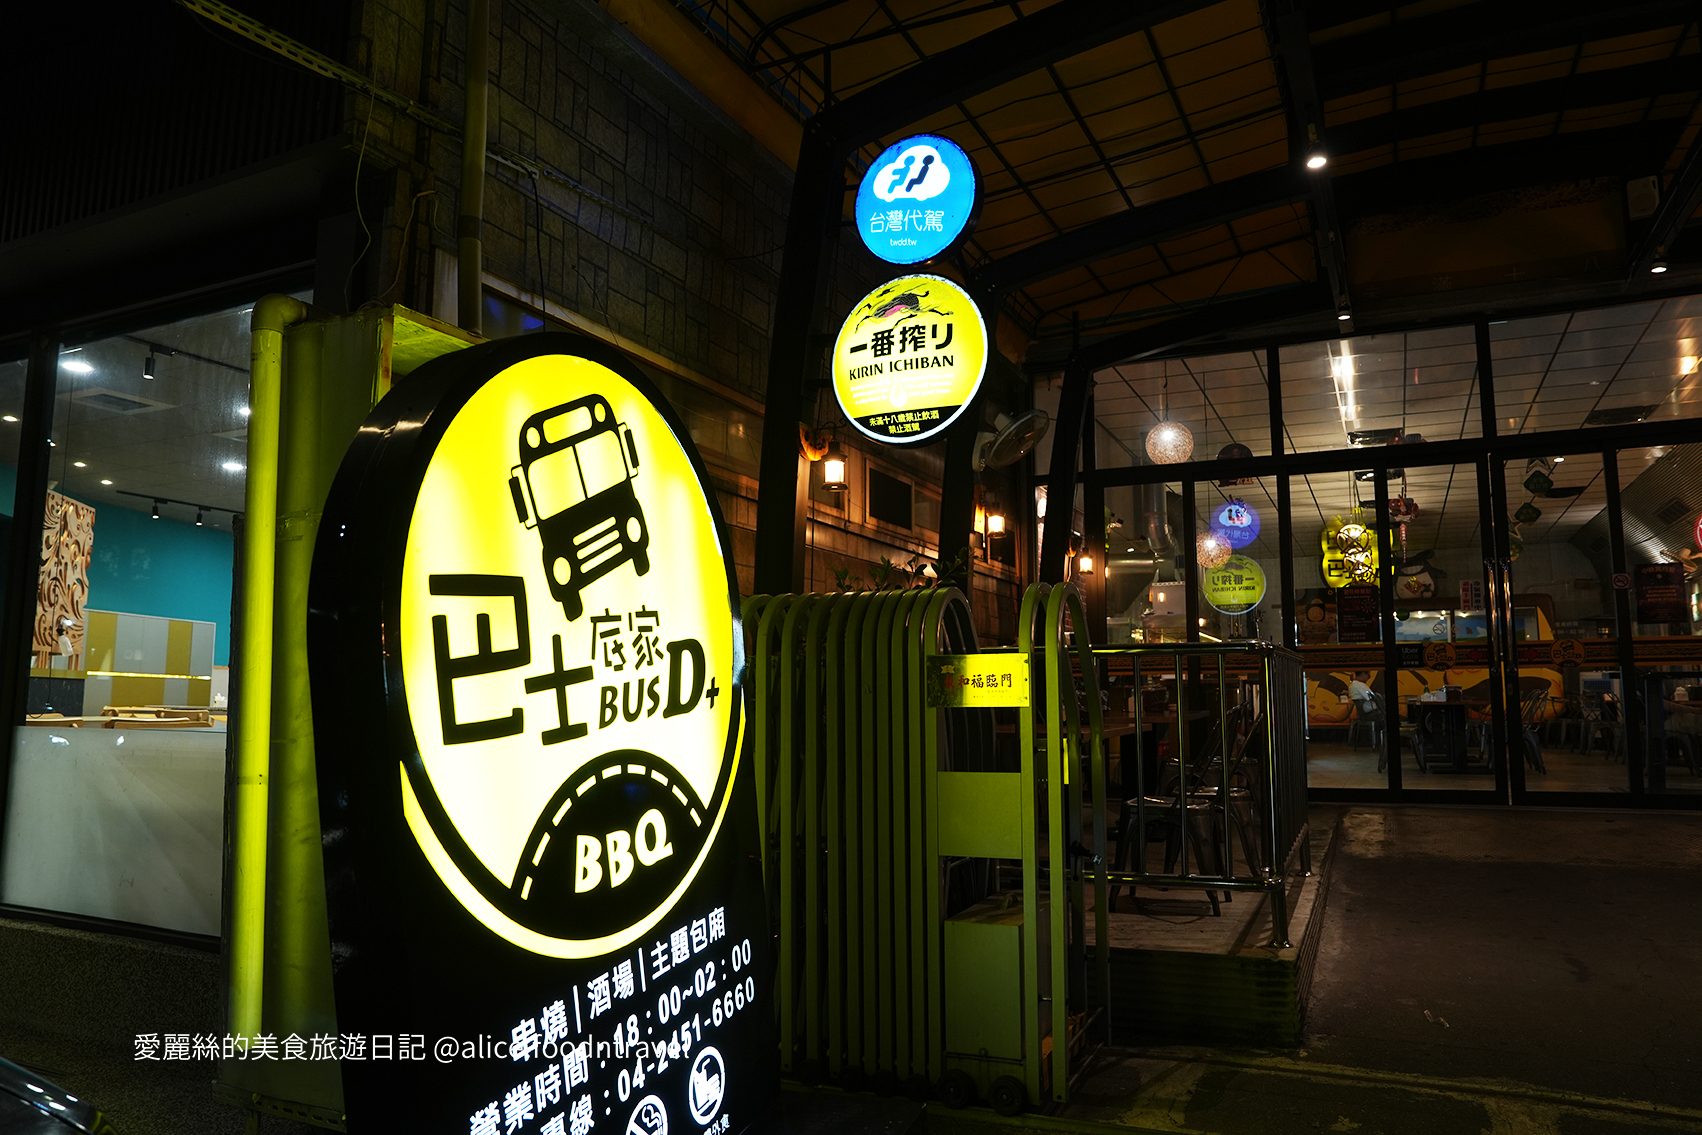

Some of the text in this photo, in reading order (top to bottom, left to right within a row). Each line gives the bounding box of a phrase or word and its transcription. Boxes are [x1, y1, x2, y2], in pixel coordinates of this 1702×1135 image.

[869, 209, 945, 233] 台灣代駕
[889, 238, 917, 246] twdd.tw
[849, 323, 954, 358] 一番搾り
[849, 355, 954, 381] KIRIN ICHIBAN
[429, 574, 595, 746] 巴士
[598, 675, 660, 729] BUS
[574, 808, 674, 893] BBQ
[510, 906, 726, 1062] 串燒 酒場 主題包廂
